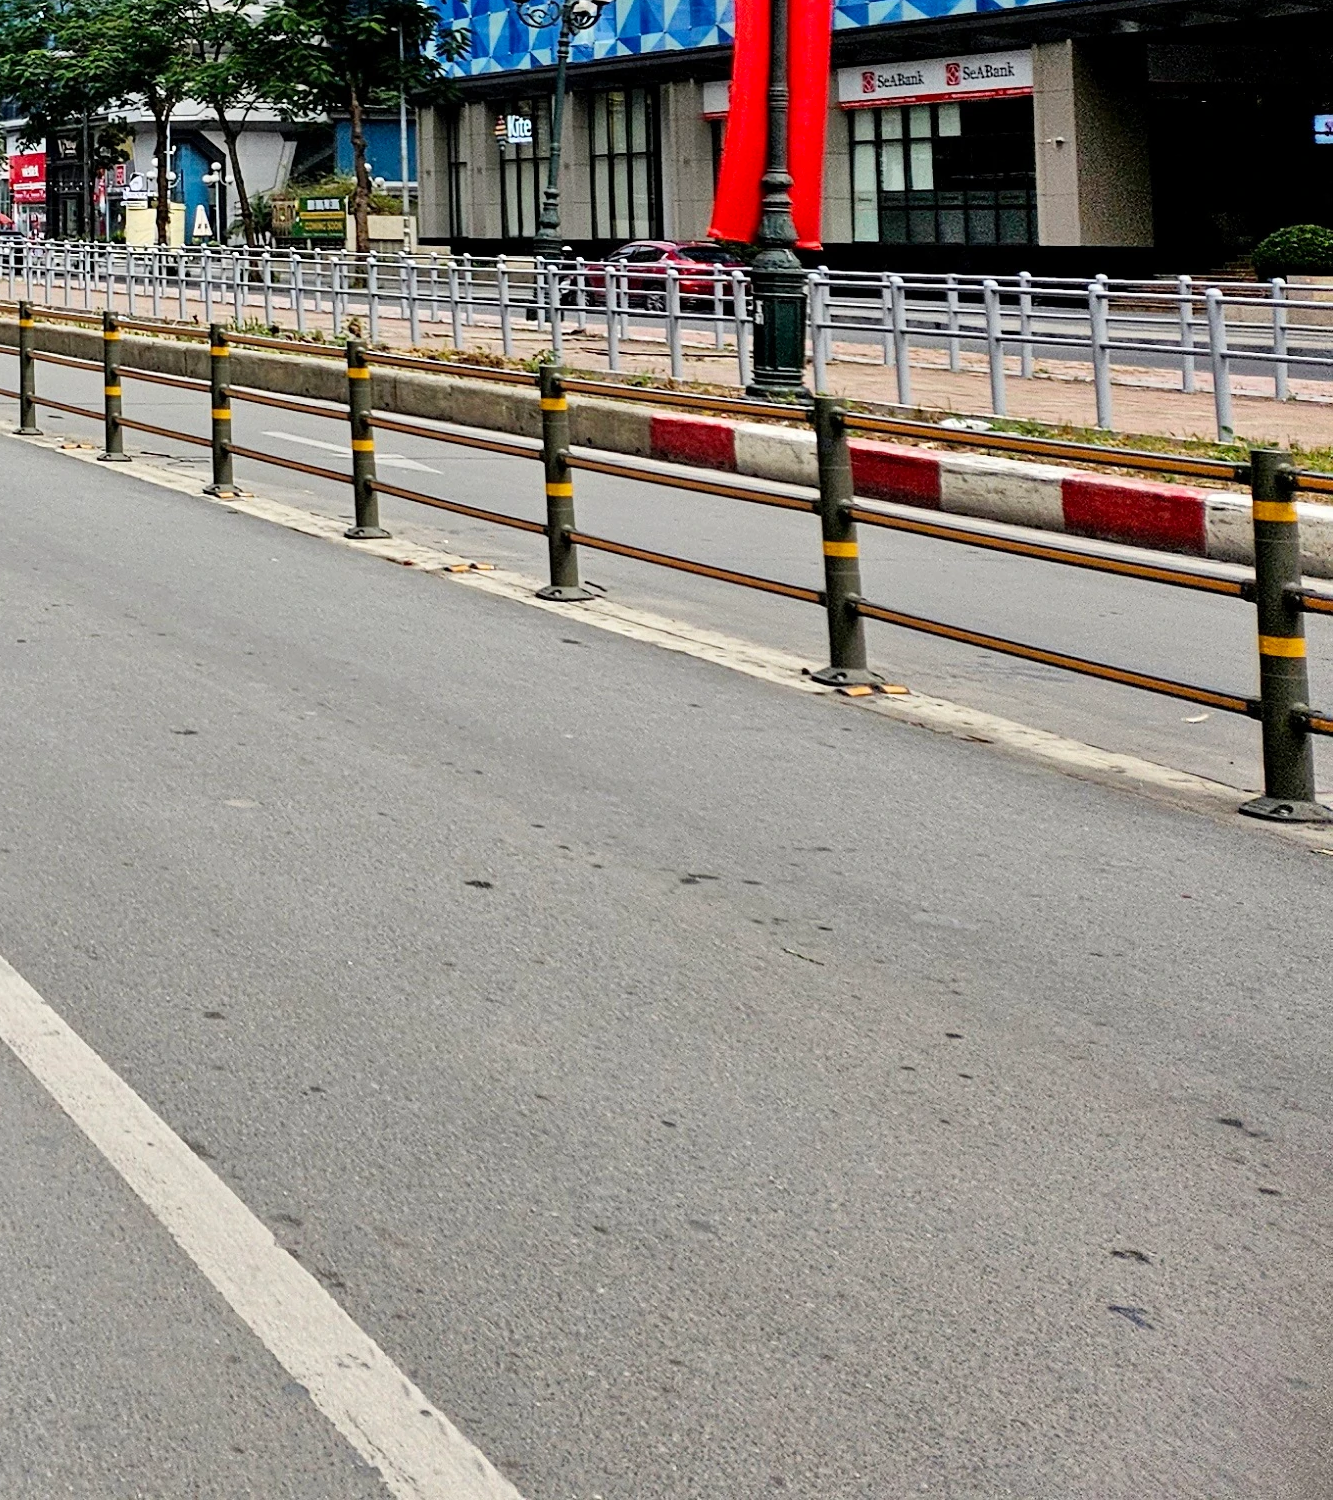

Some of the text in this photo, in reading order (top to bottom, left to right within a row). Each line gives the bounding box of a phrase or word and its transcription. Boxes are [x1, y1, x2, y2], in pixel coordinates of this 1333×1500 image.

[877, 61, 1016, 89] SeABank SeABank
[506, 114, 532, 137] Kite
